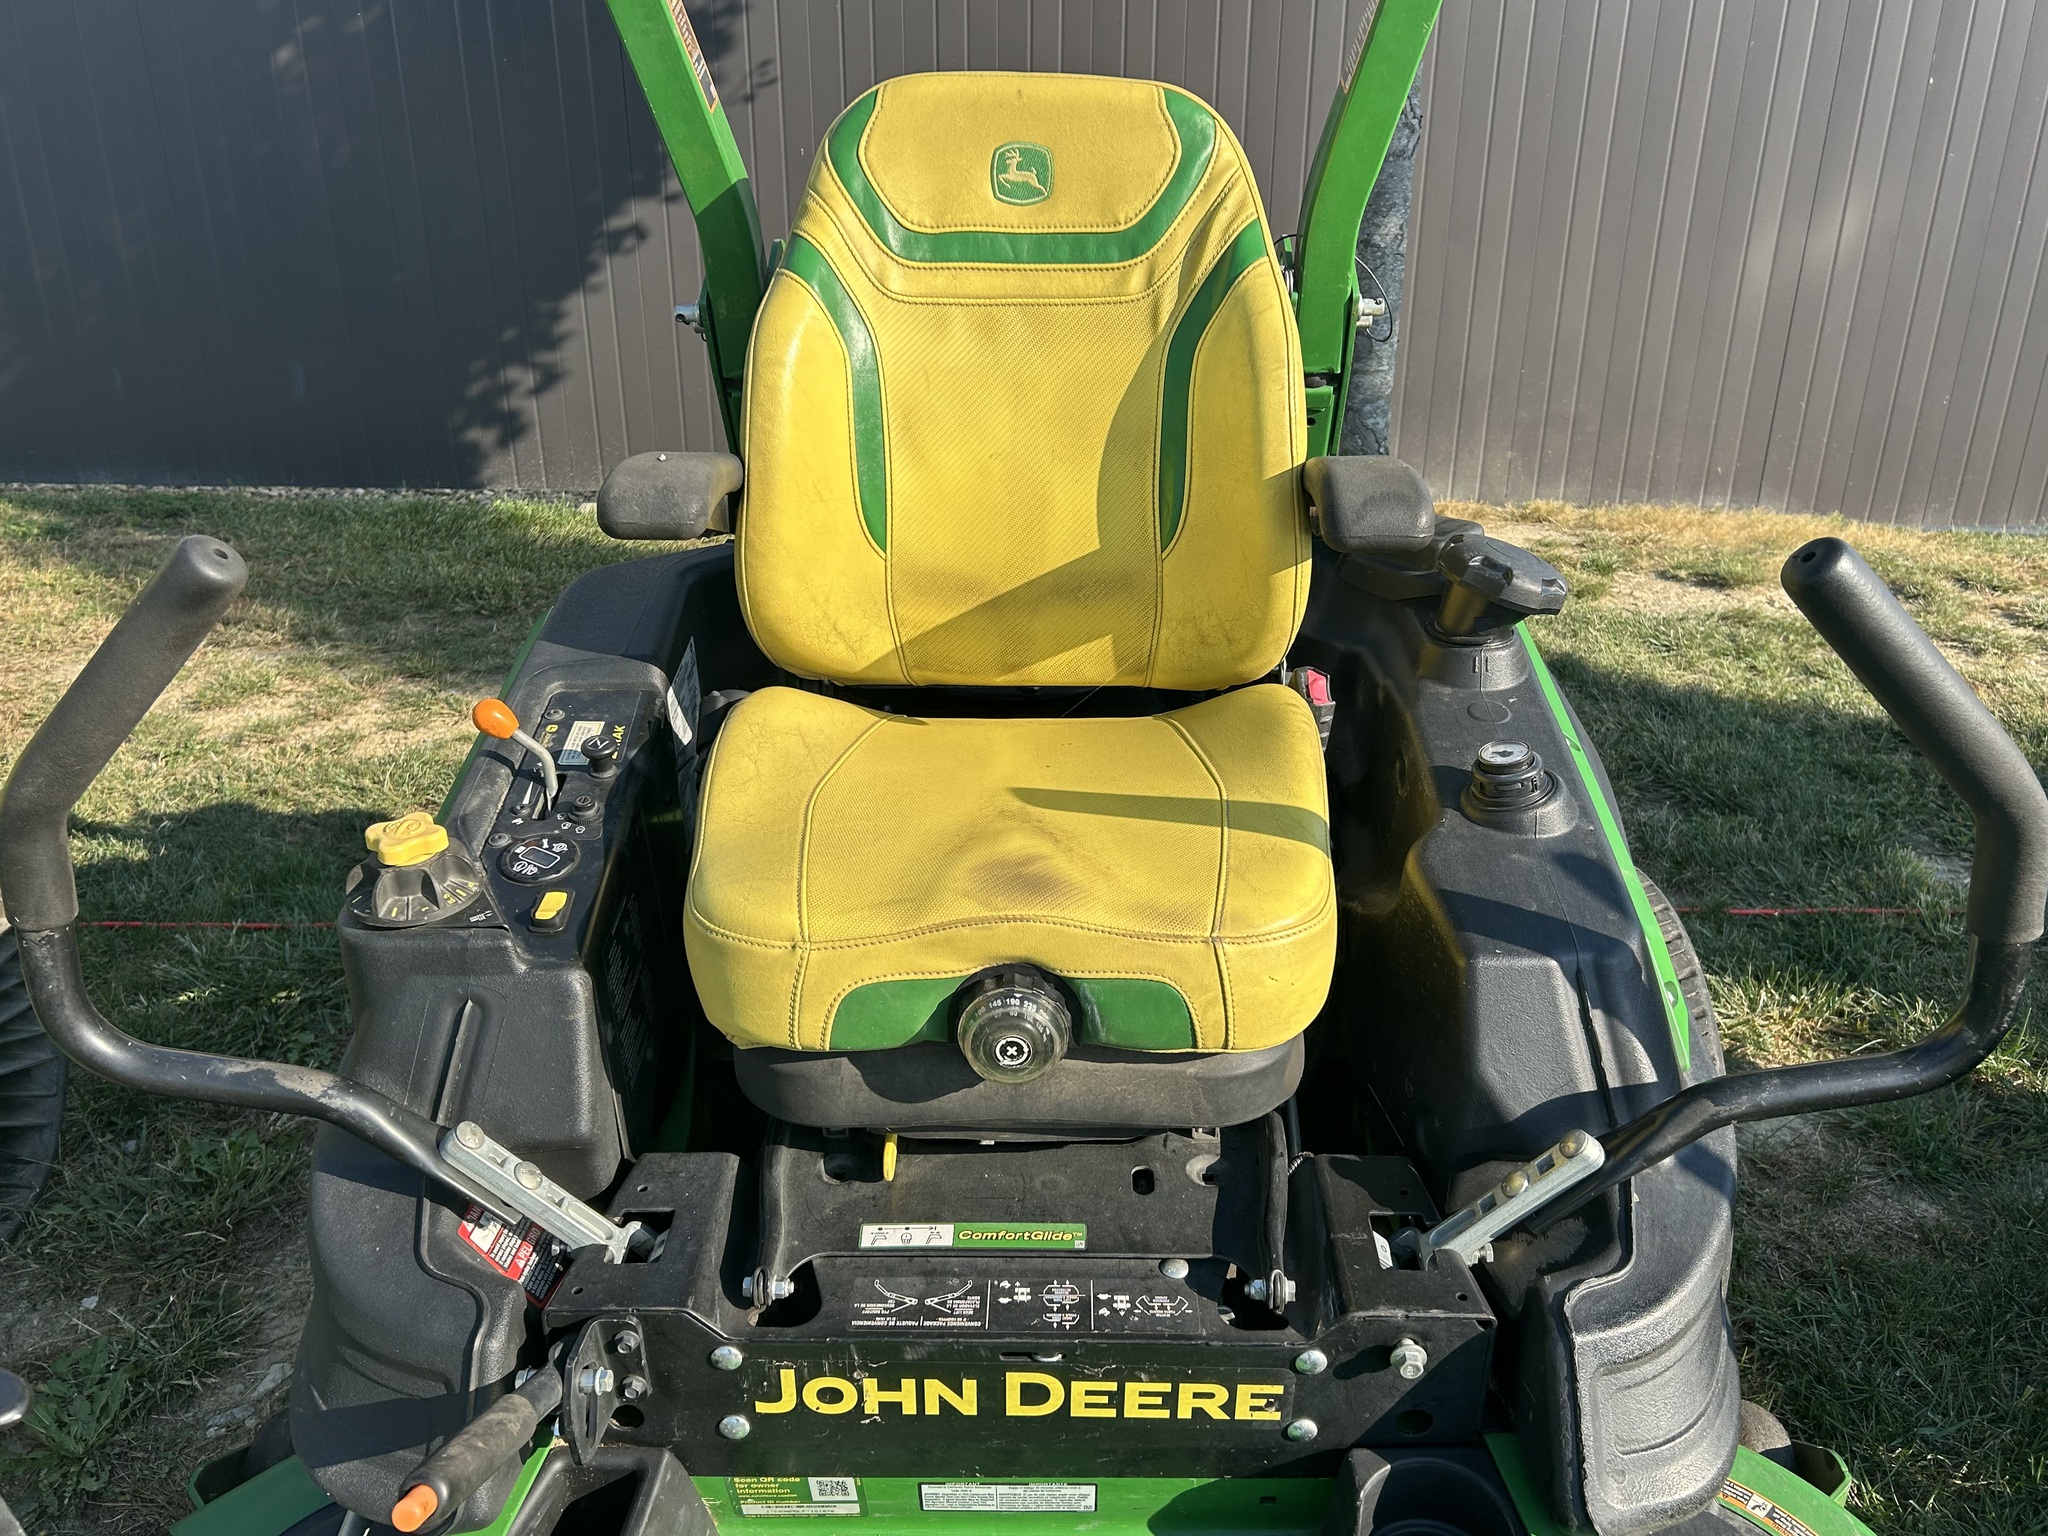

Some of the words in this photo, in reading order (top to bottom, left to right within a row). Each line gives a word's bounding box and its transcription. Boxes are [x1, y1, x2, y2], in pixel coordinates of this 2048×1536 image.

[519, 1228, 540, 1261] PELGRO
[755, 1369, 977, 1415] JOHN
[1006, 1372, 1284, 1420] DEERE
